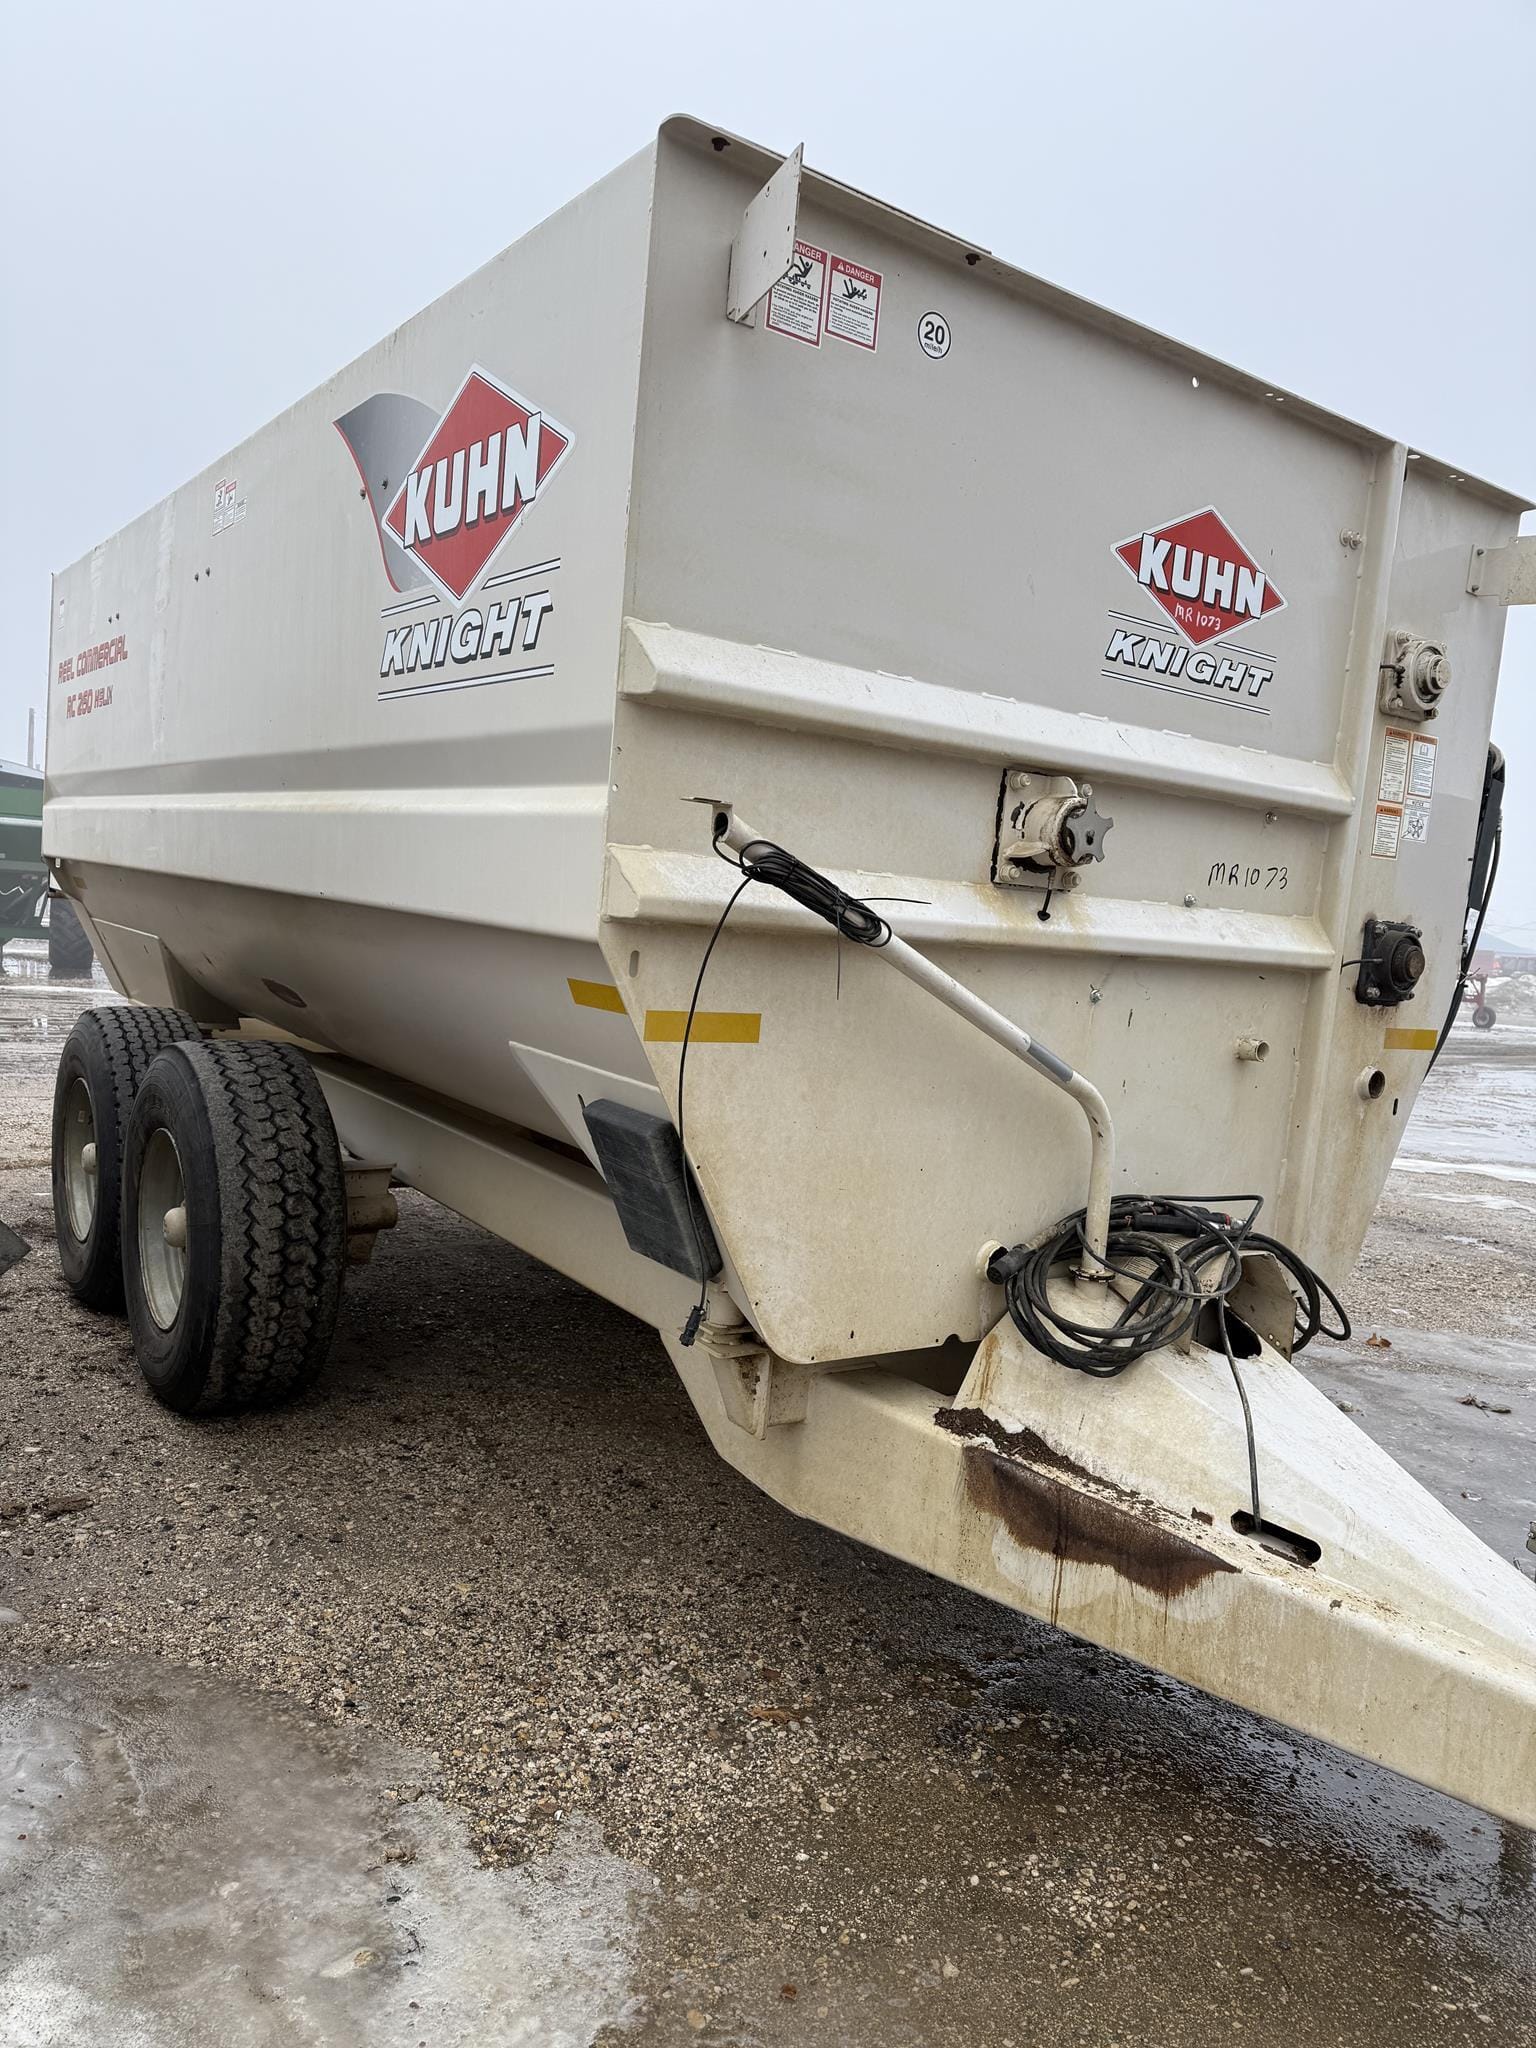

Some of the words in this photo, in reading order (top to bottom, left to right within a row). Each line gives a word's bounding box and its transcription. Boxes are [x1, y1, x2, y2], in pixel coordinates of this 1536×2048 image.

[794, 242, 822, 260] ANGER
[845, 264, 875, 283] DANGER
[924, 320, 945, 345] 20
[403, 411, 542, 550] KUHN
[1137, 532, 1267, 619] KUHN
[76, 633, 128, 677] COMMERCIAL
[380, 589, 554, 678] KNIGHT
[1105, 629, 1274, 698] KNIGHT
[67, 694, 76, 719] RC
